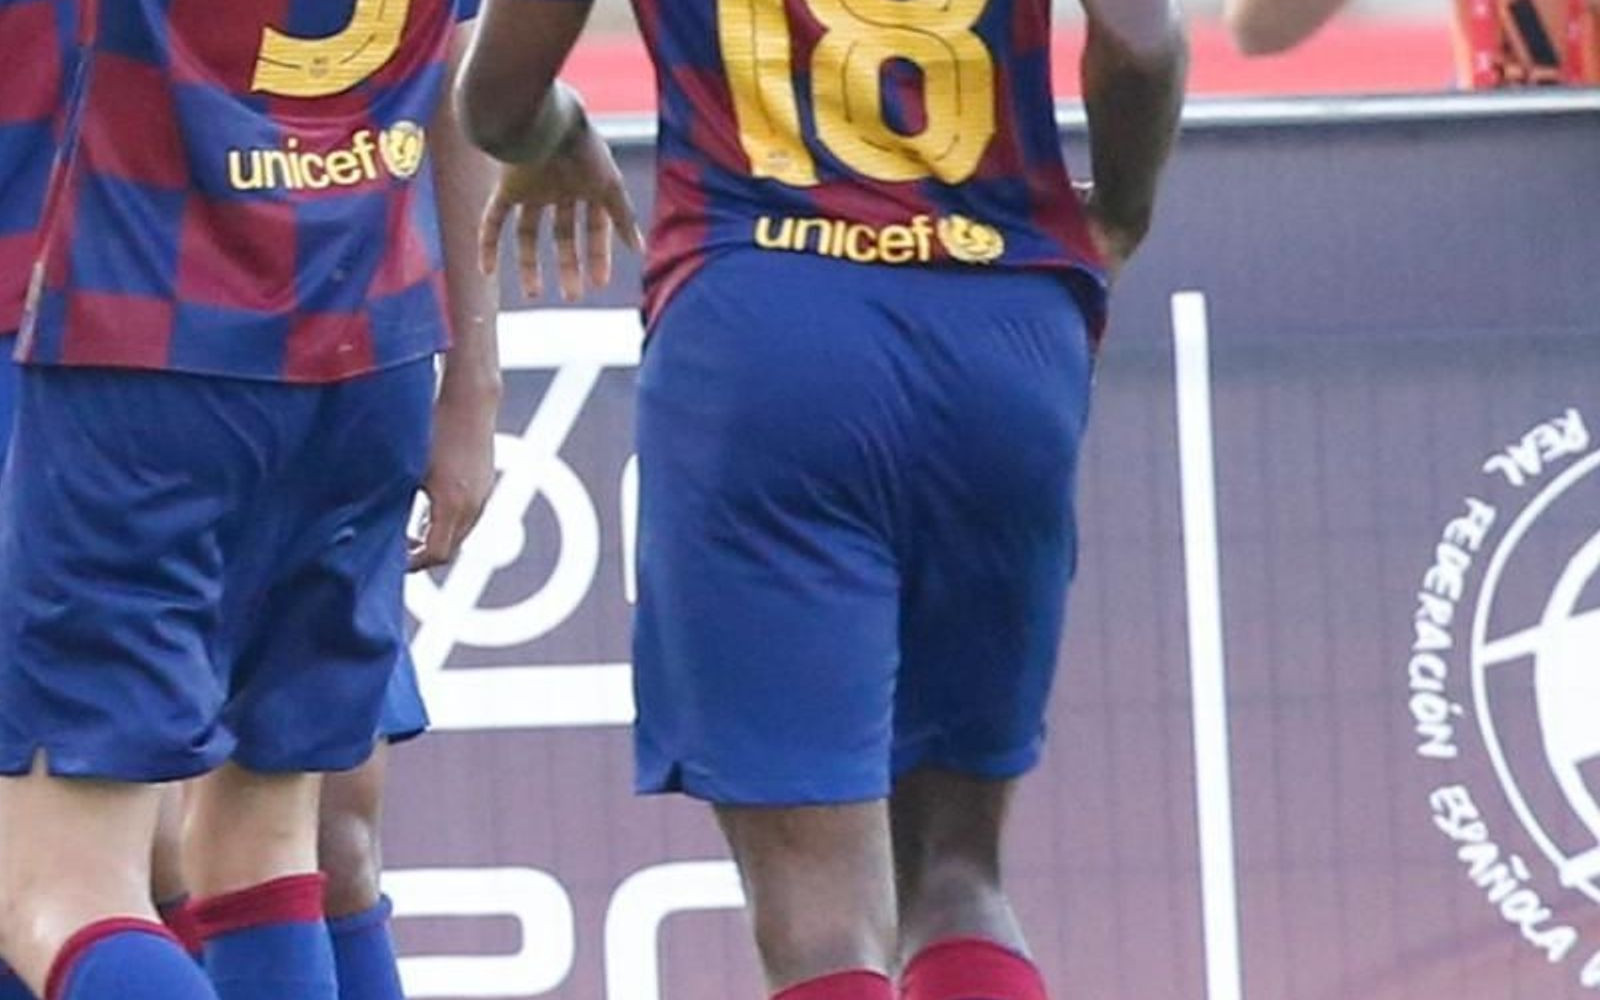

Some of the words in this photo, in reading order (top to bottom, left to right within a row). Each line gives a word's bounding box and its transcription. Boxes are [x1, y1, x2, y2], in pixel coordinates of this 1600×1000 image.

[228, 130, 378, 190] unicef
[754, 213, 935, 262] unicef
[1482, 407, 1590, 487] REAL
[1408, 497, 1496, 759] FEDERACIÓN
[1429, 784, 1578, 963] ESPAÑOLA
